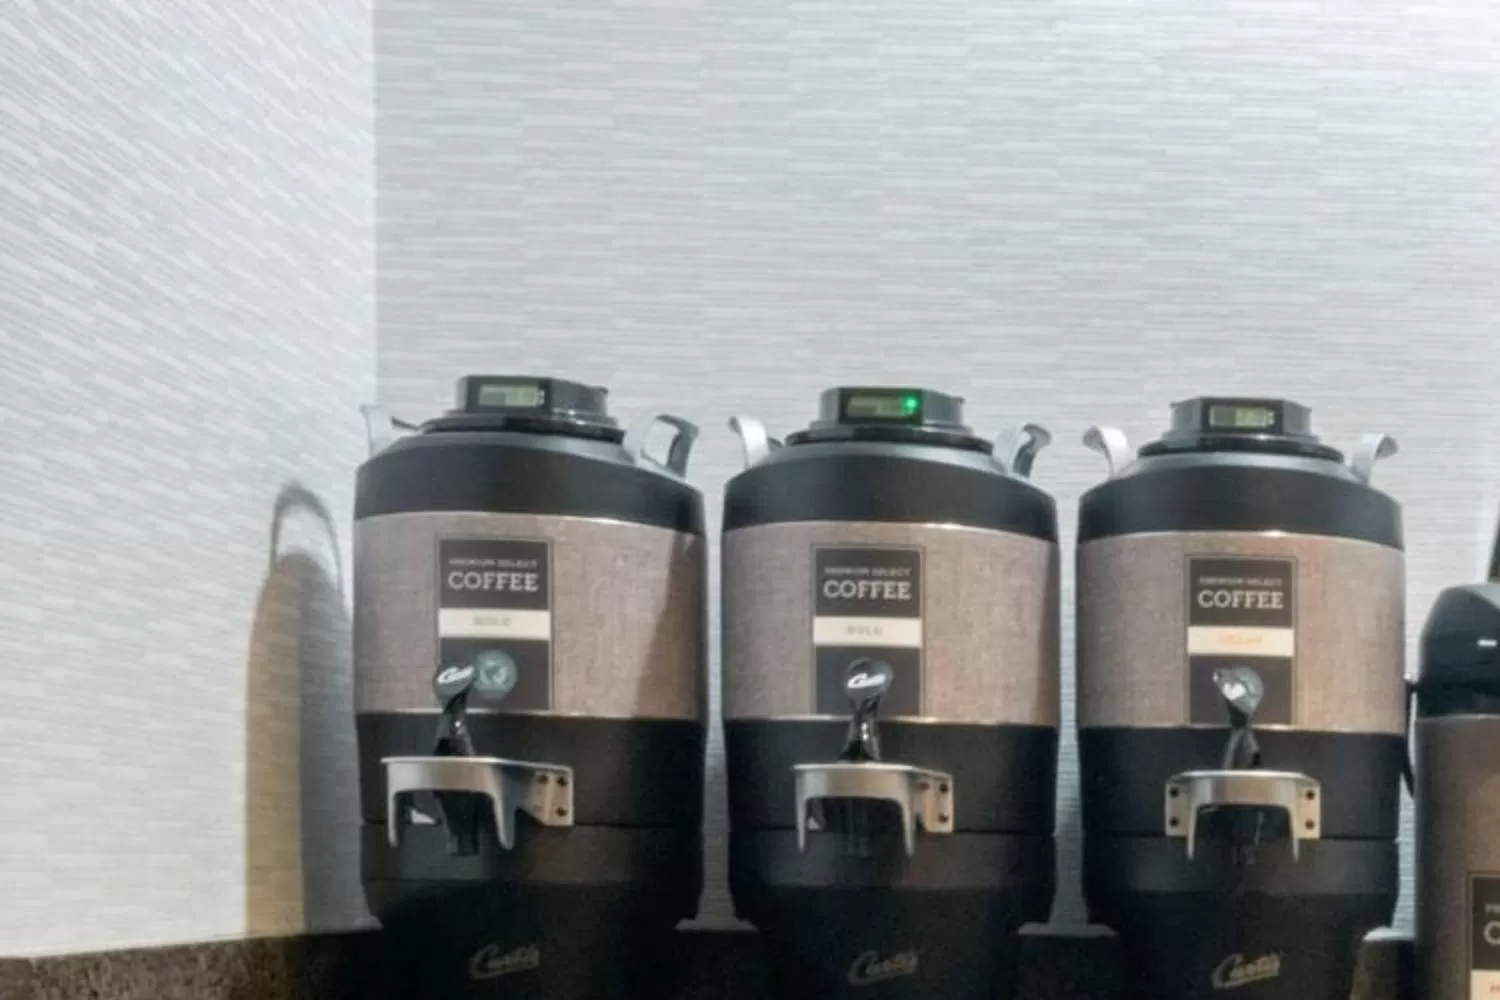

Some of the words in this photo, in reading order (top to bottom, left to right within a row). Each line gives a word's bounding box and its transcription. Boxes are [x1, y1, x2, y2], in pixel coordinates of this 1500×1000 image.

[448, 571, 539, 592] COFFEE
[823, 580, 912, 600] COFFEE
[1198, 590, 1284, 608] COFFEE
